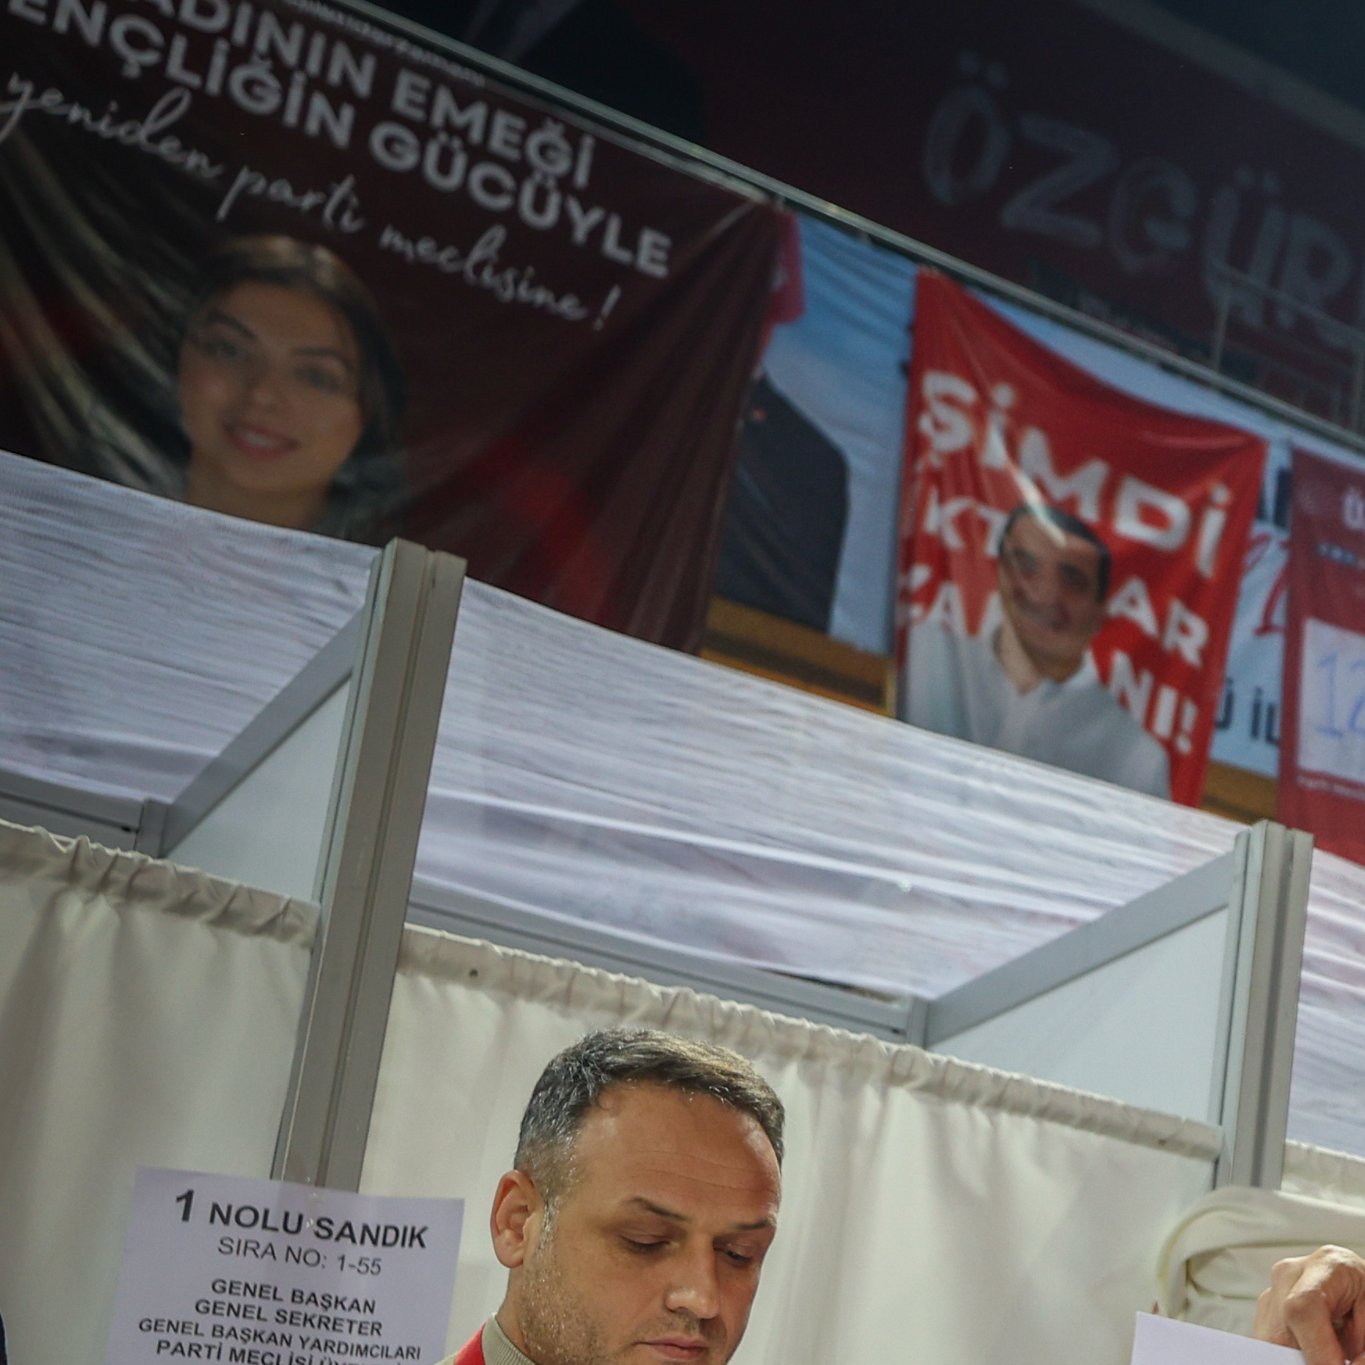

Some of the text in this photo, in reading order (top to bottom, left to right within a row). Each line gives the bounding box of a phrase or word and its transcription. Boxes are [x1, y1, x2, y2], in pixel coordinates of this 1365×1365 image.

[0, 72, 225, 180] yeniden
[392, 69, 596, 189] EMEĞİ
[369, 121, 673, 279] GÜCÜYLE
[175, 1189, 429, 1249] 1 NOLU SANDIK
[218, 1236, 382, 1277] SIRA NO: 1-55
[194, 1298, 382, 1337] GENEL SEKRETER
[211, 1278, 375, 1315] GENEL BAŞKAN
[139, 1318, 421, 1362] GENEL BAŞKAN YARDIMCILARI
[156, 1339, 222, 1361] PARTİ
